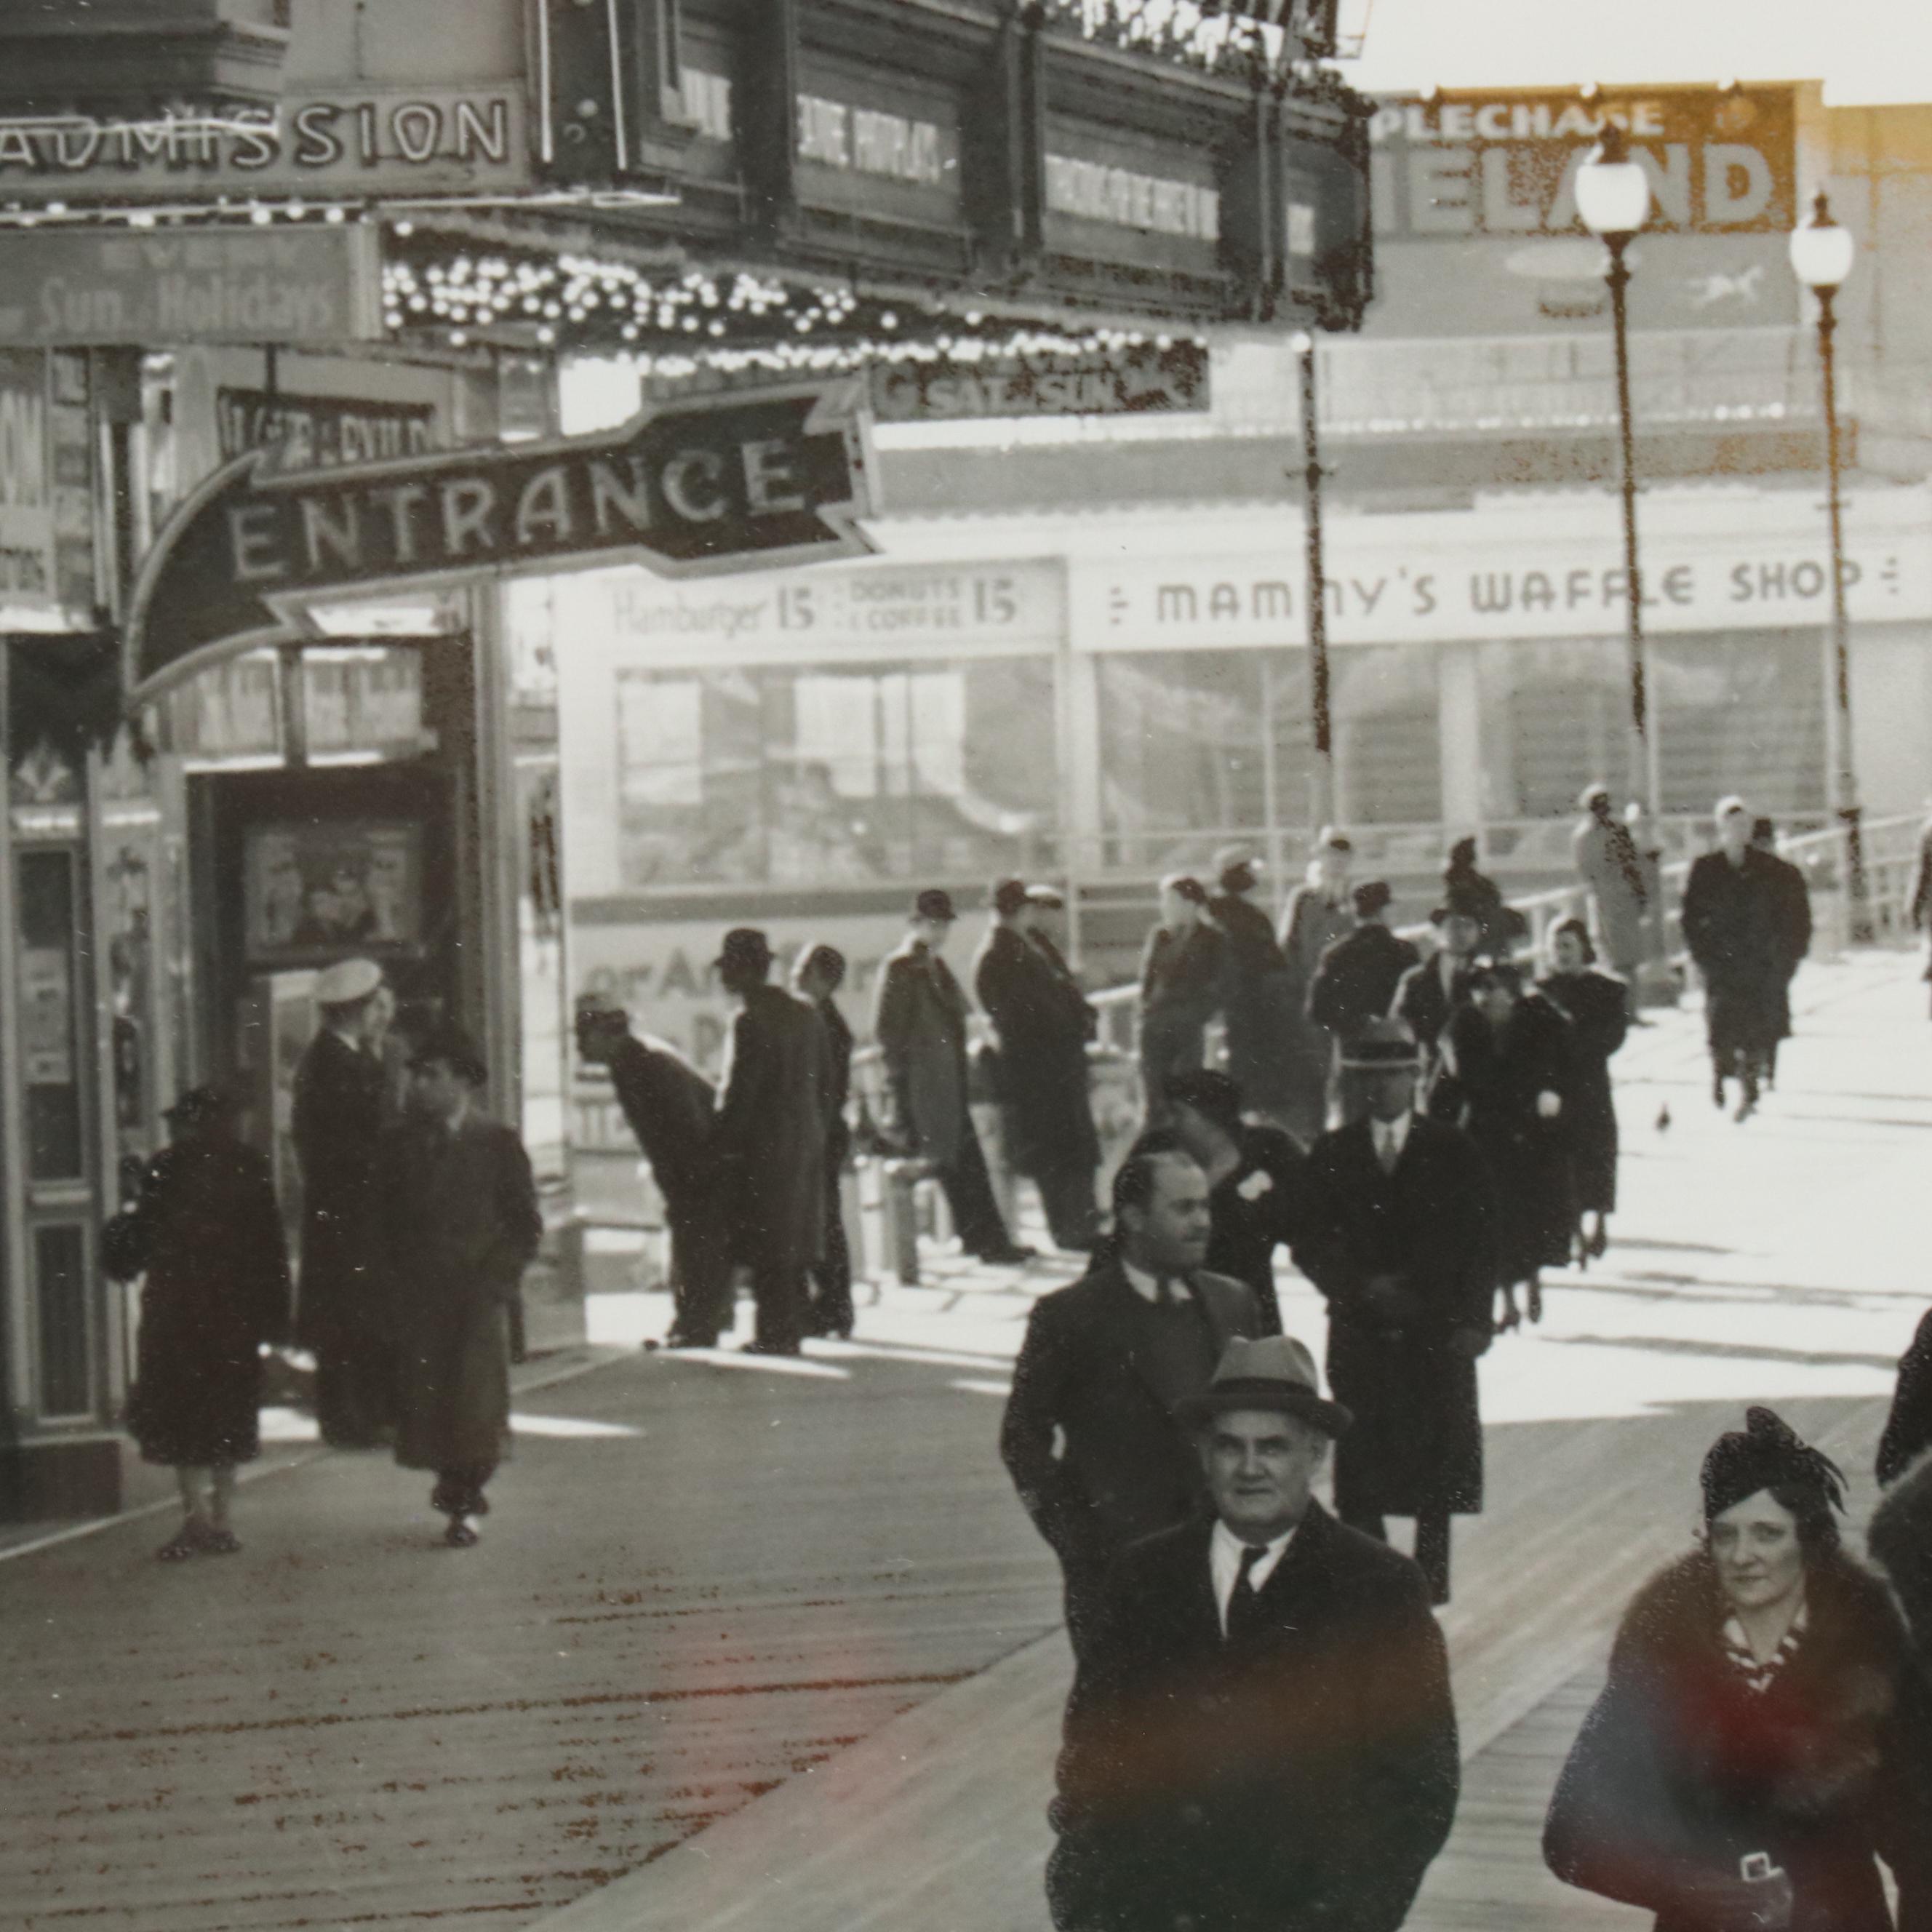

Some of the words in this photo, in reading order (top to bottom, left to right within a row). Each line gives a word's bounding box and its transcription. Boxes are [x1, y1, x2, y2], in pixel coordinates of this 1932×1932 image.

[0, 102, 504, 167] ADMISSION
[227, 439, 805, 580] ENTRANCE
[974, 578, 1016, 623] 15
[1730, 559, 1862, 603] SHOP
[778, 586, 814, 630] 15
